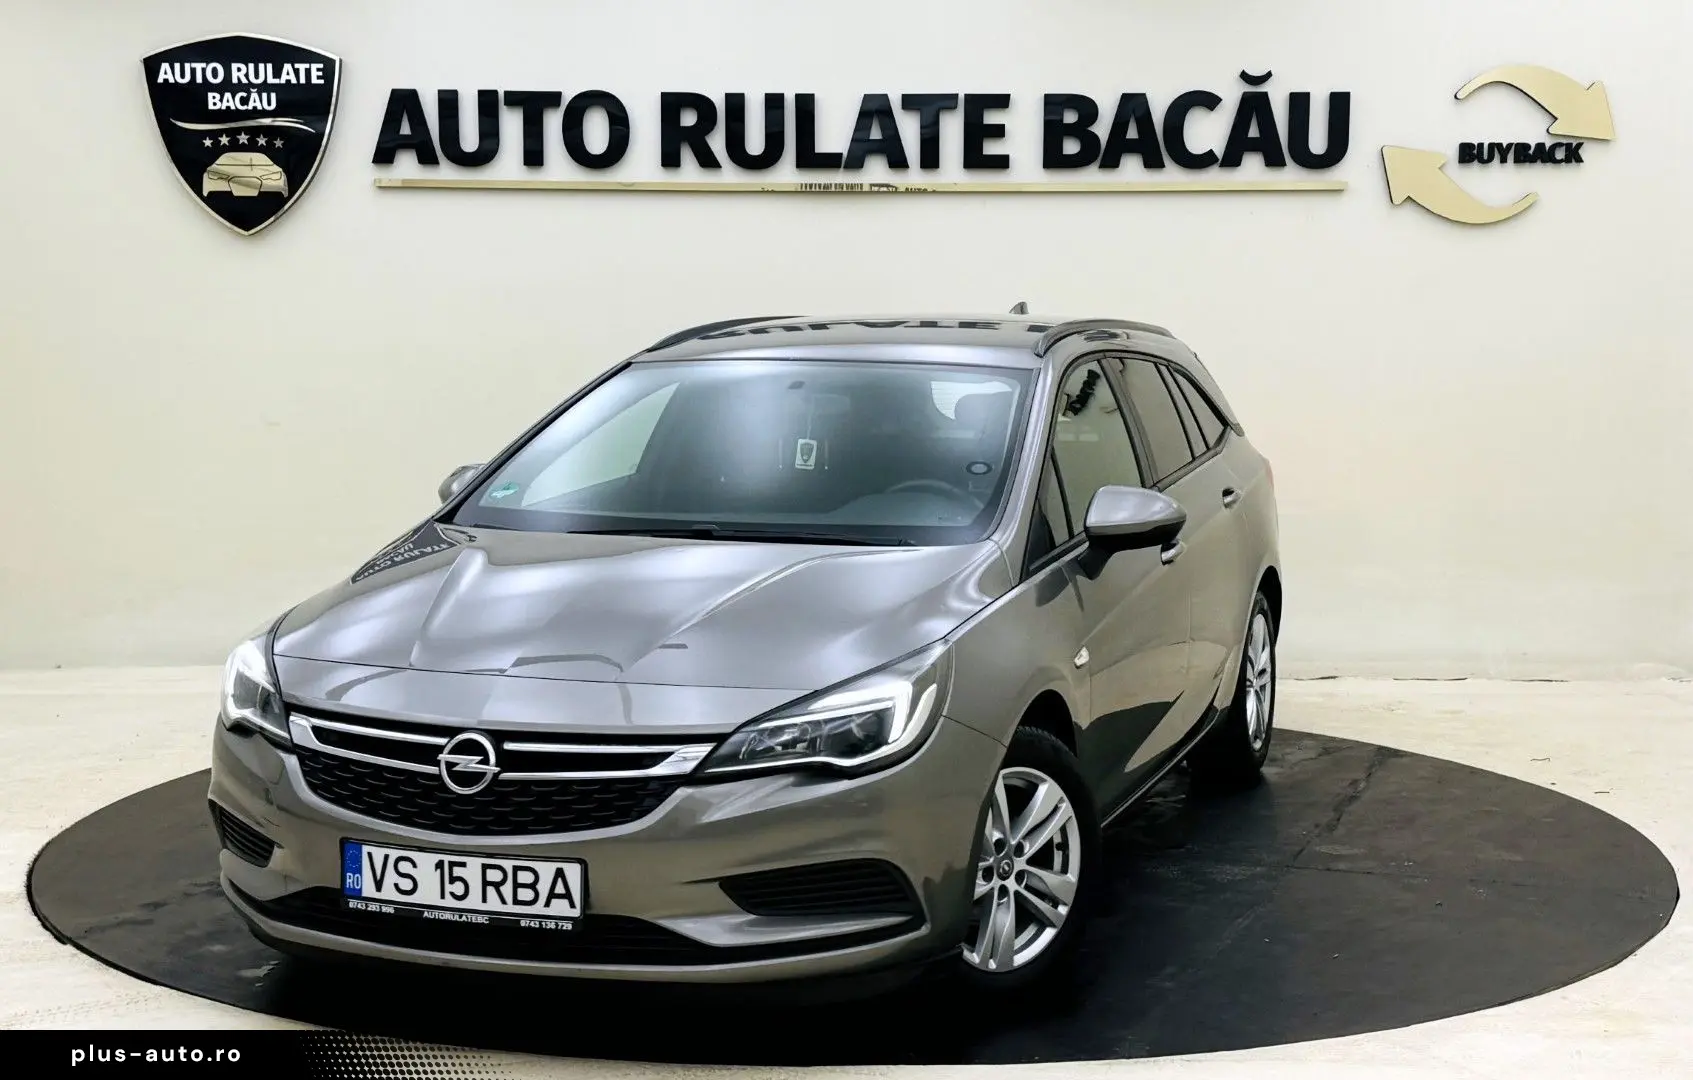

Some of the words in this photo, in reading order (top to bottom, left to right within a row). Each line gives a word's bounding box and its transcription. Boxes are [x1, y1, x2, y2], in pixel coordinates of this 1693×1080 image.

[157, 62, 224, 84] AUTO
[231, 62, 325, 84] RULATE
[207, 88, 277, 110] BACĂU
[372, 88, 630, 170] AUTO
[660, 91, 1010, 170] RULATE
[1042, 69, 1352, 170] BACĂU
[1458, 141, 1585, 165] BUYBACK
[345, 872, 362, 890] RO
[367, 851, 418, 897] VS
[434, 859, 470, 902] 15
[481, 862, 577, 910] RBA
[423, 910, 490, 924] AUTORULATEBC
[520, 919, 540, 928] 0743
